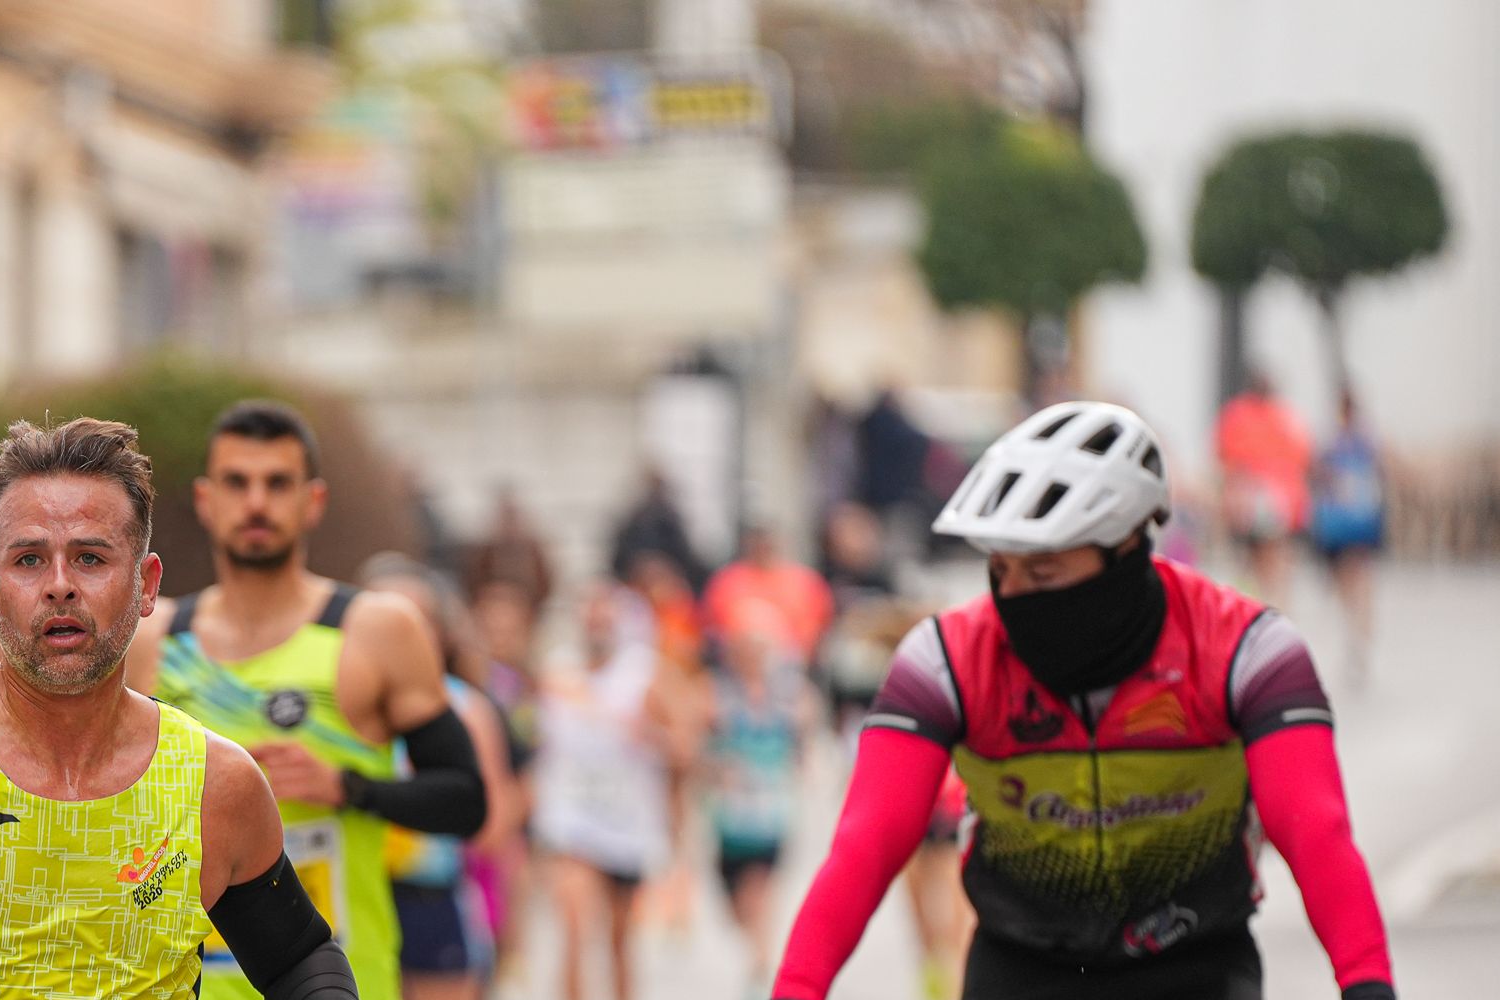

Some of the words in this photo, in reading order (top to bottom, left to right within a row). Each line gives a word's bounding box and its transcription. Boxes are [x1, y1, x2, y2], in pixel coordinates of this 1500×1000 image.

[132, 880, 150, 898] NEW
[150, 862, 170, 882] YORK
[170, 849, 185, 866] CITY
[138, 861, 157, 882] MIGUEL
[137, 887, 163, 910] 2020
